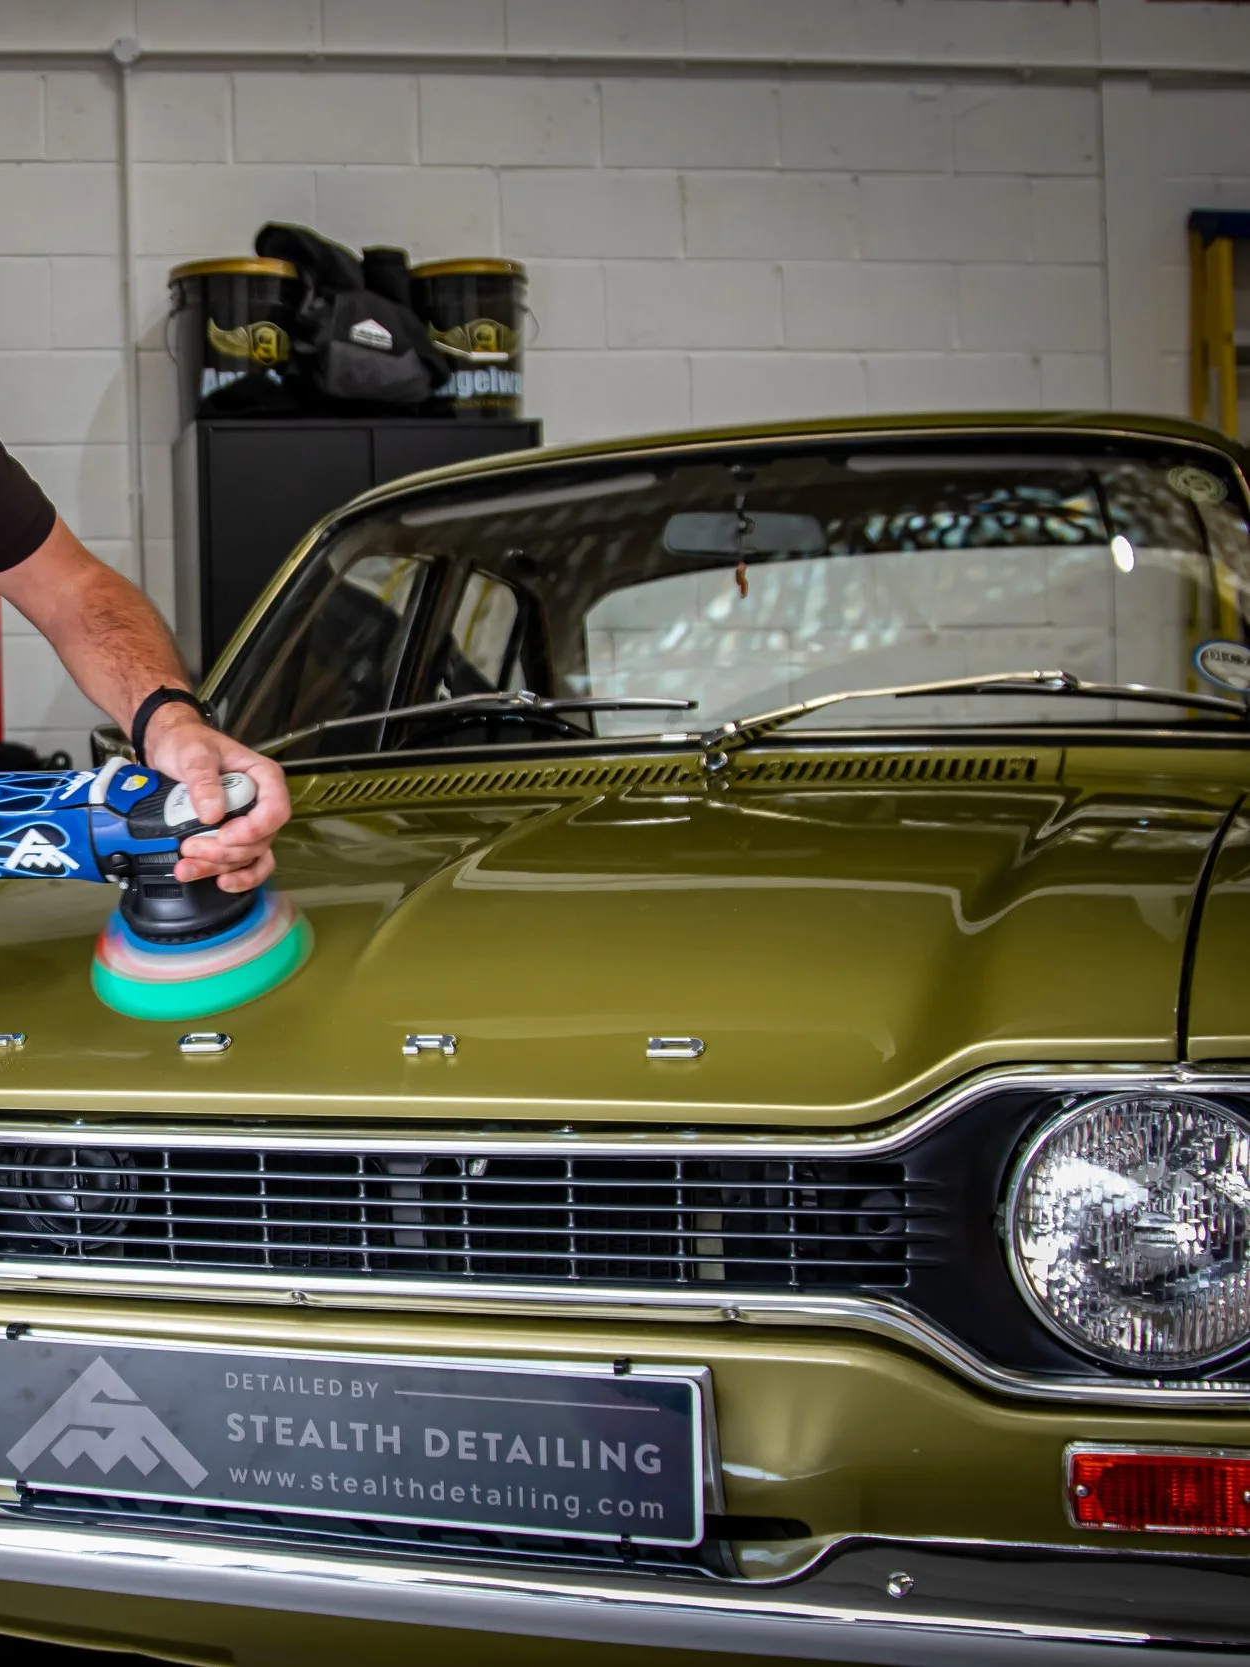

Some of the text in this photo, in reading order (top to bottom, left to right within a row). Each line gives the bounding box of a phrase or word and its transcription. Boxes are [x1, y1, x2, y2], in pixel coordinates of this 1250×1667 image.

[225, 1372, 380, 1399] DETAILED BY
[226, 1413, 662, 1475] STEALTH DETAILING
[229, 1466, 665, 1520] www.stealthdetailing.com
